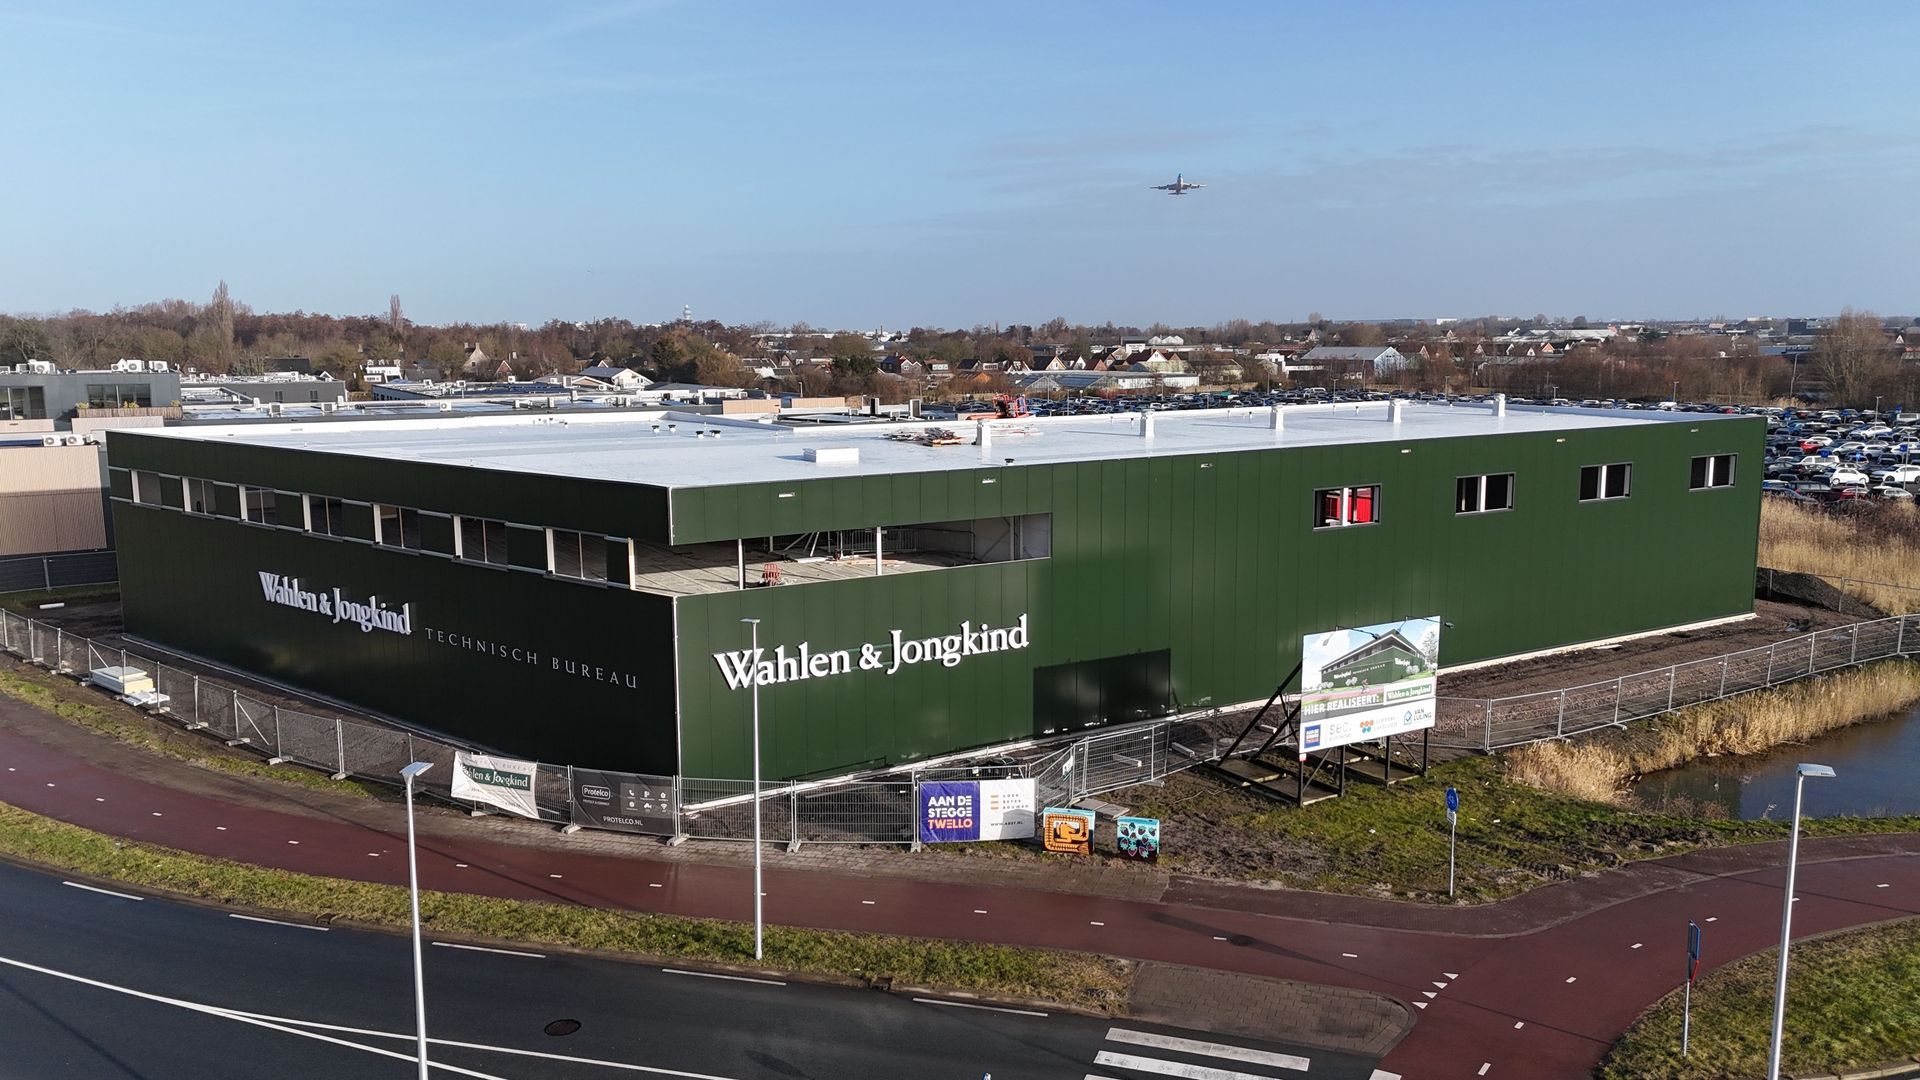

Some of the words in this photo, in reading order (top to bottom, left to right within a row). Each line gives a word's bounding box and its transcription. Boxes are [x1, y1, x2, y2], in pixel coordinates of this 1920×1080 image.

[258, 571, 318, 612] Wahlen
[319, 593, 333, 615] &
[332, 588, 411, 635] Jongkind
[712, 641, 851, 690] Wahlen
[858, 644, 883, 670] &
[887, 614, 1029, 674] Jongkind
[425, 628, 537, 664] TECHNISCH
[552, 657, 636, 689] BUREAU
[1304, 704, 1325, 715] HIER
[1327, 694, 1379, 711] REALISEERT:
[484, 772, 491, 781] &
[583, 788, 608, 797] Protelco
[928, 796, 954, 806] AAN
[958, 795, 972, 806] DE
[928, 807, 972, 818] STEGGE
[603, 816, 643, 826] PROTELCO.NL
[928, 818, 973, 829] TWELLO
